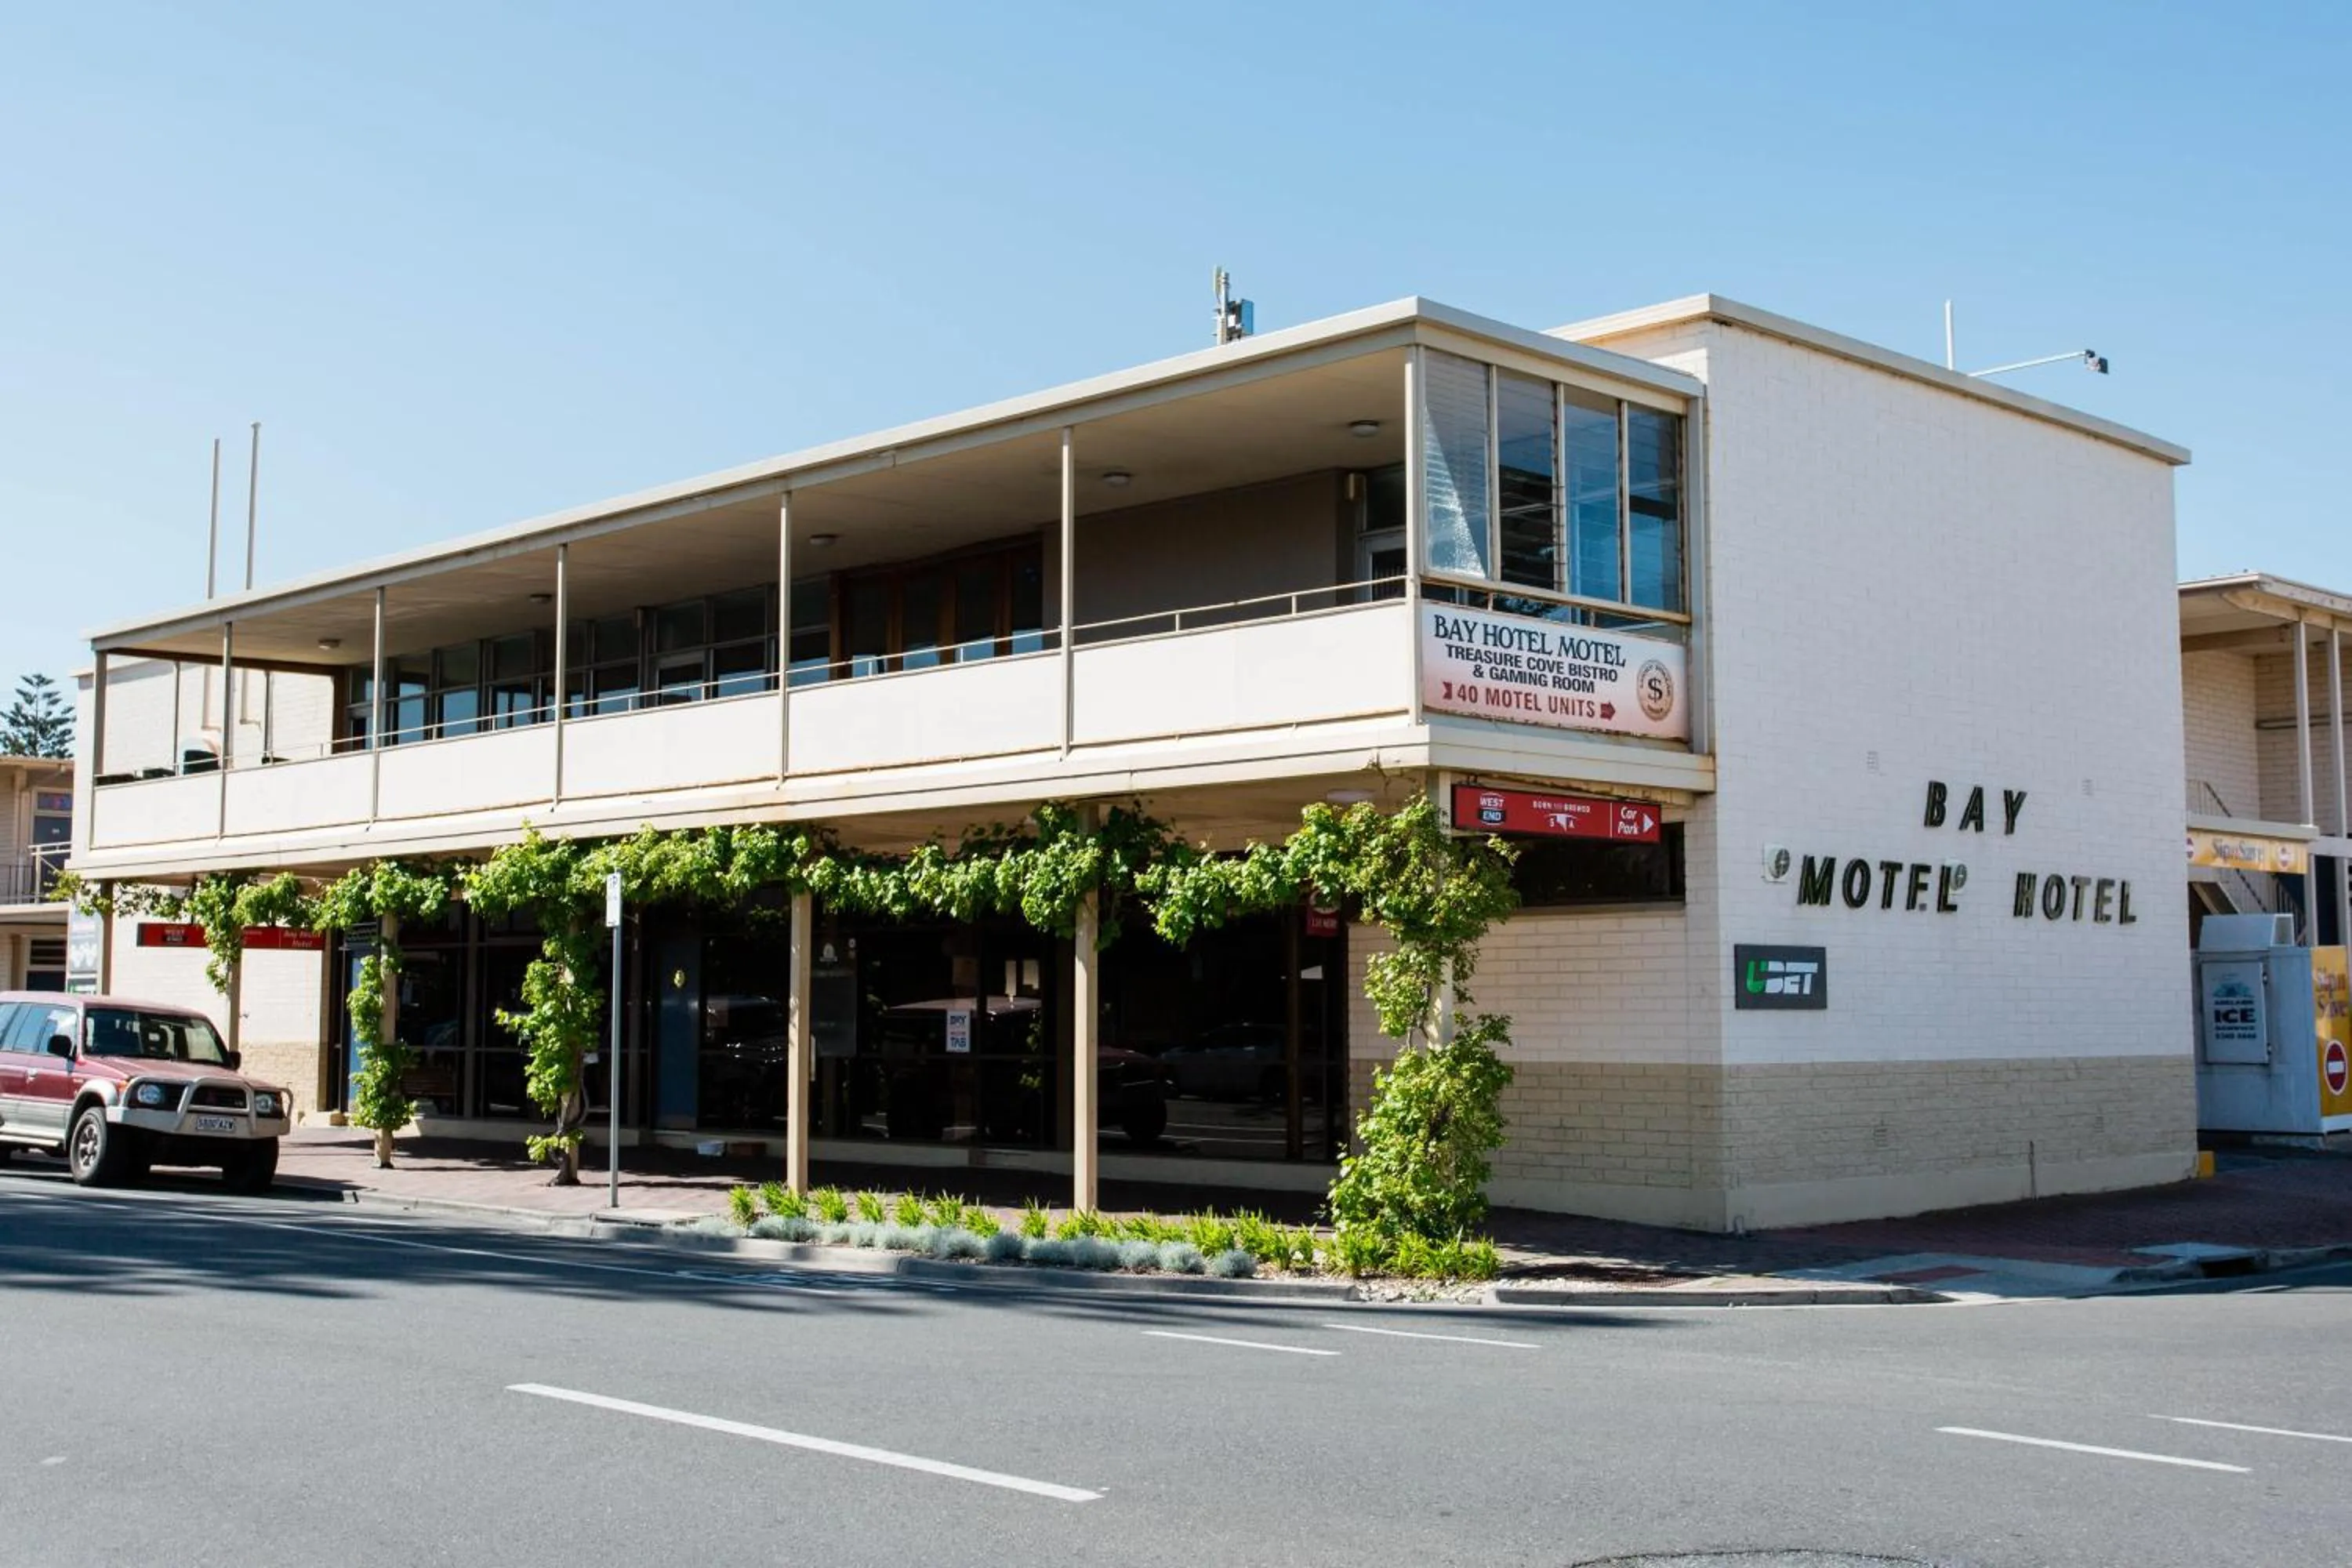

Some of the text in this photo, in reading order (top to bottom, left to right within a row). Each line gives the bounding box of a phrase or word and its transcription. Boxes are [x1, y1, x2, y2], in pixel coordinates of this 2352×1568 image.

[1434, 615, 1627, 668] BAY HOTEL MOTEL
[1445, 644, 1523, 669] TREASURE
[1526, 656, 1564, 674] COVE
[1569, 662, 1618, 683] BISTRO
[1473, 664, 1595, 693] & GAMING ROOM
[1457, 684, 1595, 717] 40 MOTEL UNITS
[1479, 797, 1504, 808] WEST
[1483, 810, 1501, 821] END
[1621, 807, 1637, 819] Car
[1924, 781, 2027, 835] BAY
[1618, 822, 1638, 834] Park
[1797, 854, 2137, 925] MOTEL HOTEL
[2214, 1007, 2256, 1023] ICE
